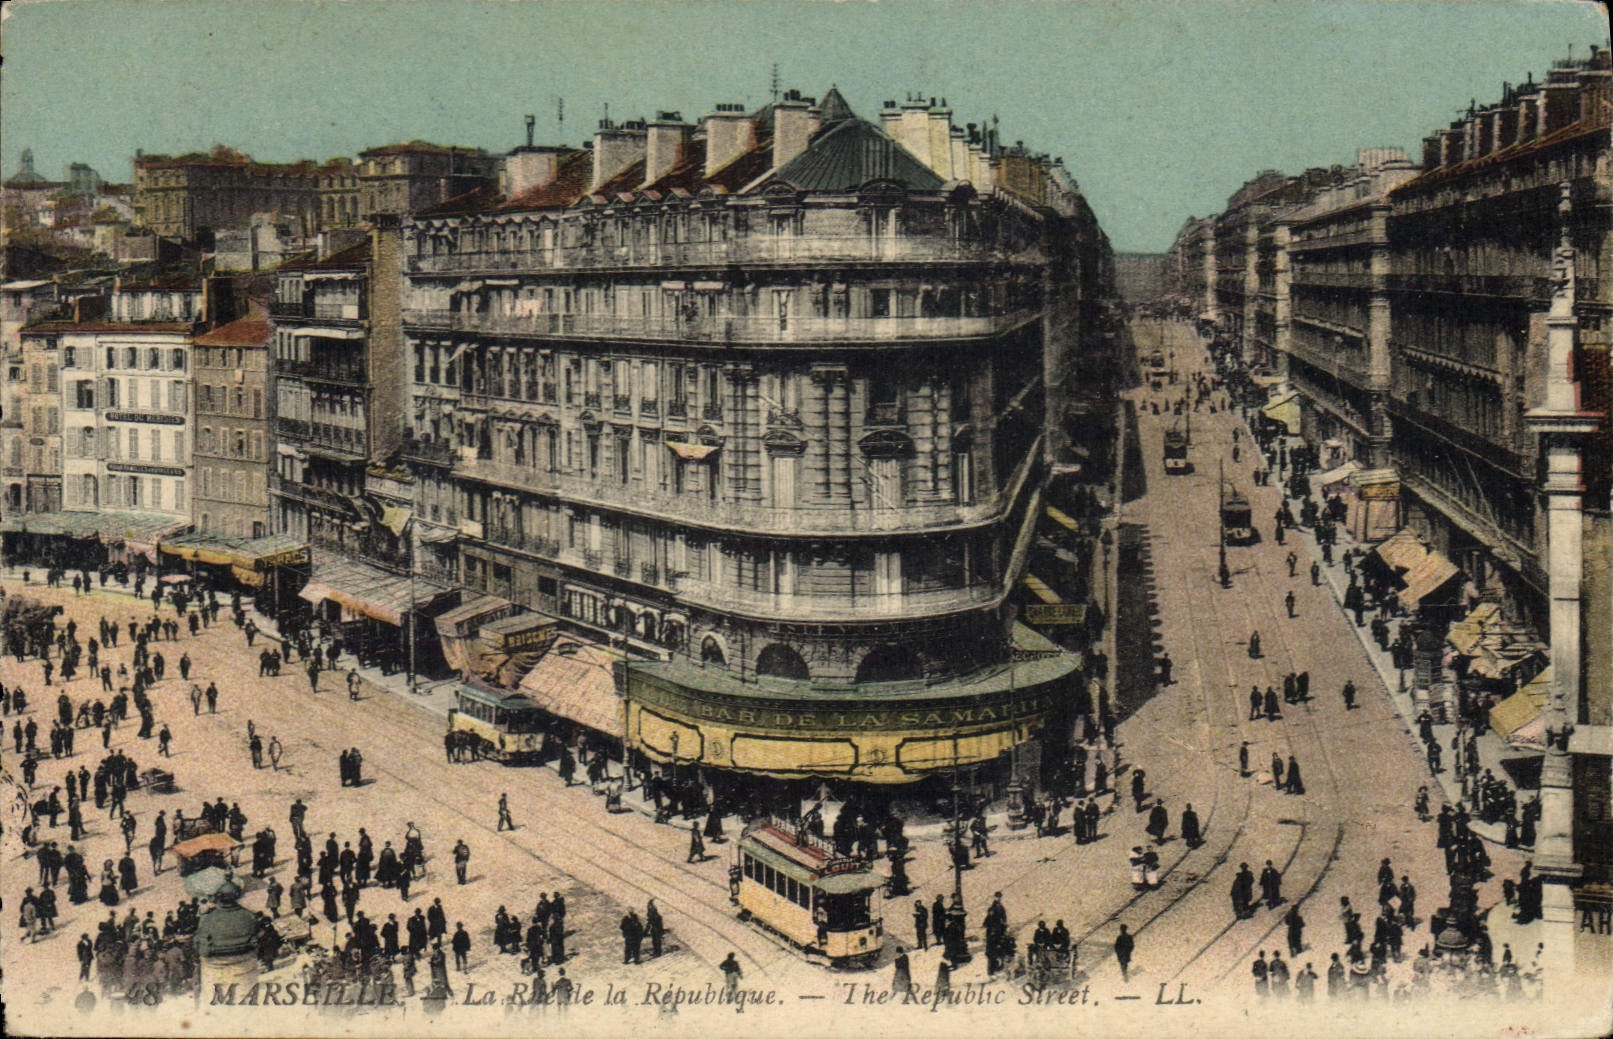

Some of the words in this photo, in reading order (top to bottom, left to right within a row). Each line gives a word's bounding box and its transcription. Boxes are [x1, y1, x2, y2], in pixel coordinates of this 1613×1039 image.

[700, 706, 755, 723] BAR
[775, 713, 816, 727] DE
[840, 713, 882, 727] LA
